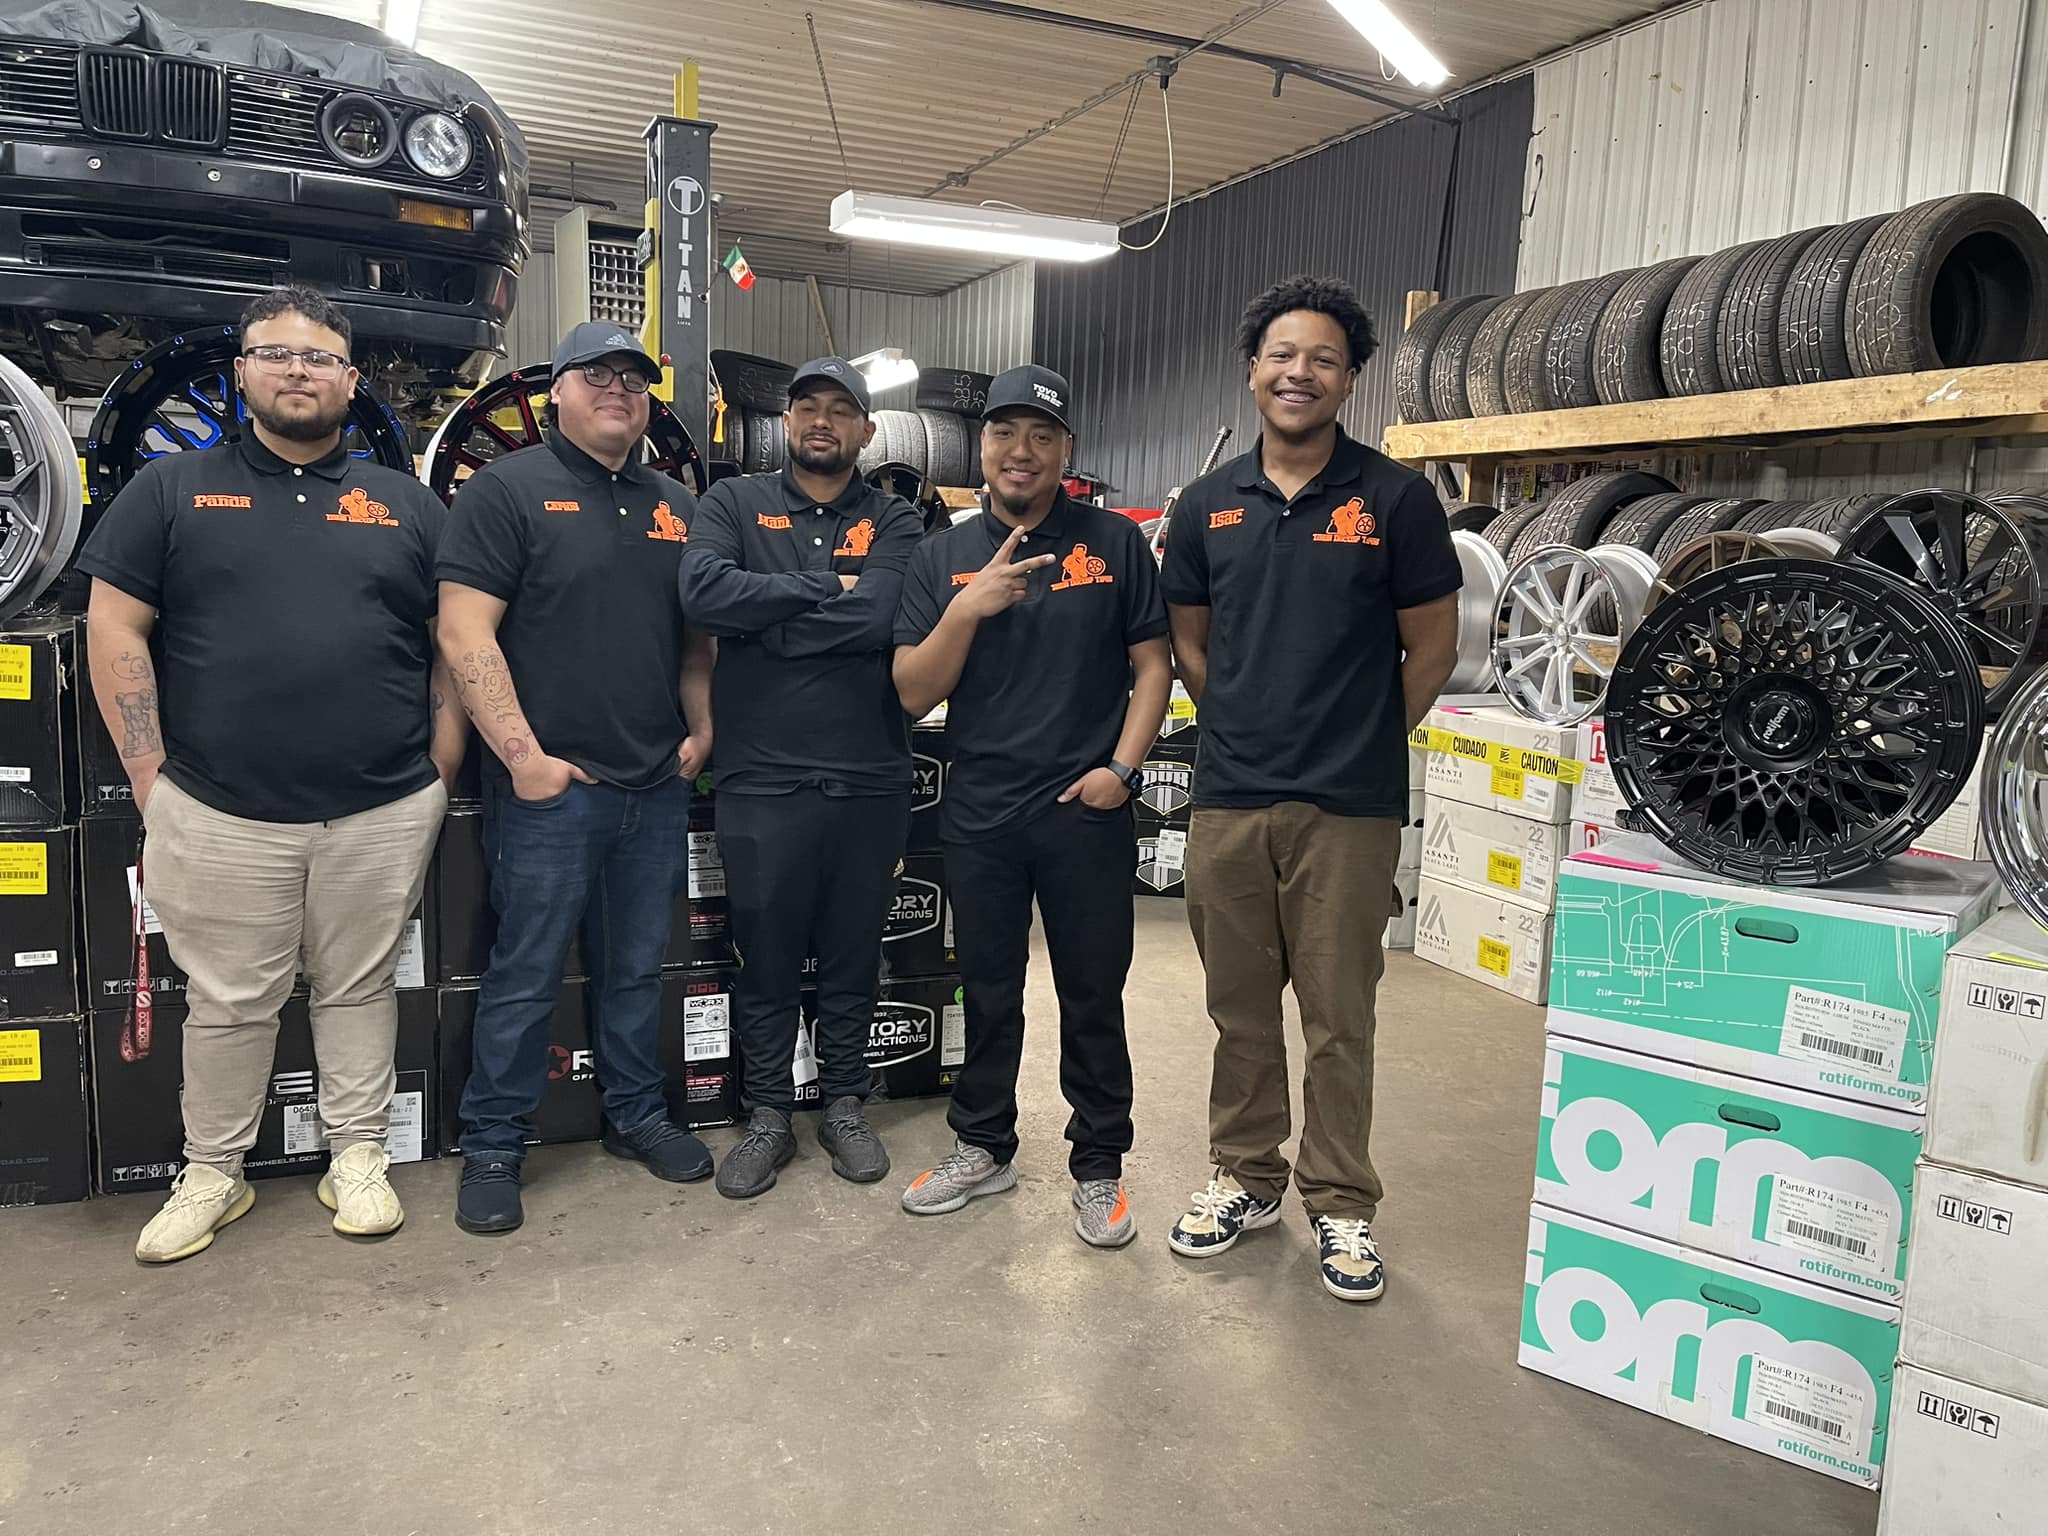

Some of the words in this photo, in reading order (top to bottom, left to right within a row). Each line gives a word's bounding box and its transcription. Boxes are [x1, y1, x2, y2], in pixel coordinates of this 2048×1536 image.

[674, 180, 699, 319] TITAN
[1786, 320, 1823, 352] 50
[1663, 336, 1694, 364] 50
[952, 374, 973, 409] 285
[1033, 383, 1058, 398] TOYO
[1552, 373, 1576, 400] 17
[1036, 391, 1064, 408] TIRES
[194, 495, 252, 508] Panda
[1209, 508, 1245, 528] Isac
[1763, 706, 1790, 740] rotiform
[1533, 734, 1550, 751] 22
[1453, 736, 1487, 759] CUIDADO
[1521, 752, 1559, 776] CAUTION
[1142, 769, 1189, 789] DUB
[1429, 766, 1463, 778] ASANTI
[1528, 825, 1545, 844] 22
[1425, 849, 1459, 864] ASANTI
[1518, 914, 1533, 933] 22
[1418, 930, 1451, 946] ASANTI
[1872, 1009, 1886, 1021] F4
[138, 1012, 149, 1049] sparco
[1819, 1070, 1922, 1102] rotiform.com
[1550, 1097, 1902, 1281] orm
[1855, 1201, 1868, 1211] F4
[1800, 1258, 1899, 1294] rotiform.com
[1535, 1267, 1878, 1466] orm
[1830, 1384, 1843, 1395] F4
[1778, 1438, 1872, 1477] rotiform.com
